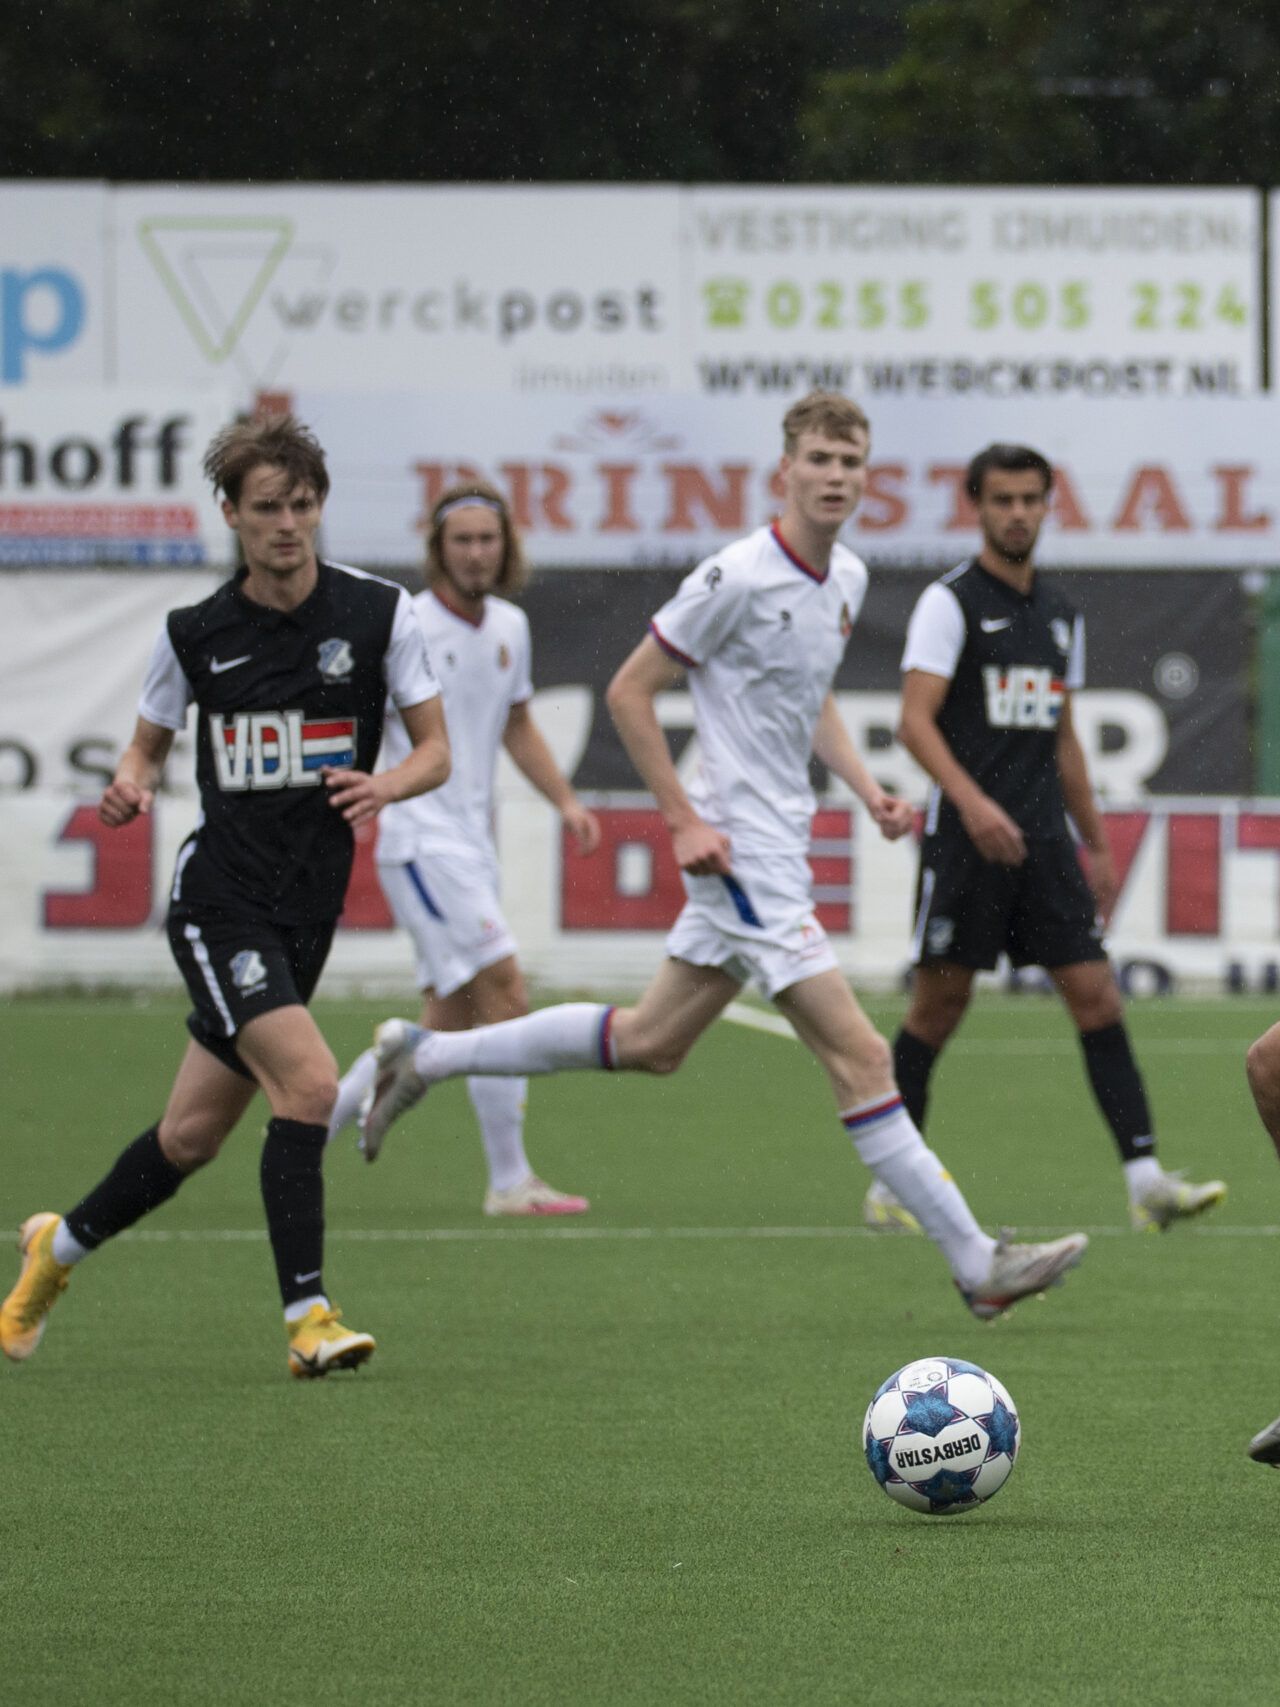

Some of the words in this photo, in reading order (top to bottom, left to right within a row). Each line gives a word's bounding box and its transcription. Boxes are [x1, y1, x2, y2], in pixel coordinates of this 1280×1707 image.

[700, 208, 968, 252] VESTIGING
[272, 280, 668, 344] werckpost
[765, 281, 932, 330] 0255
[971, 281, 1090, 330] 505
[1132, 281, 1246, 330] 224
[981, 663, 1062, 730] VDL
[208, 708, 324, 792] VDL
[895, 1433, 983, 1469] DERBYSTAR
